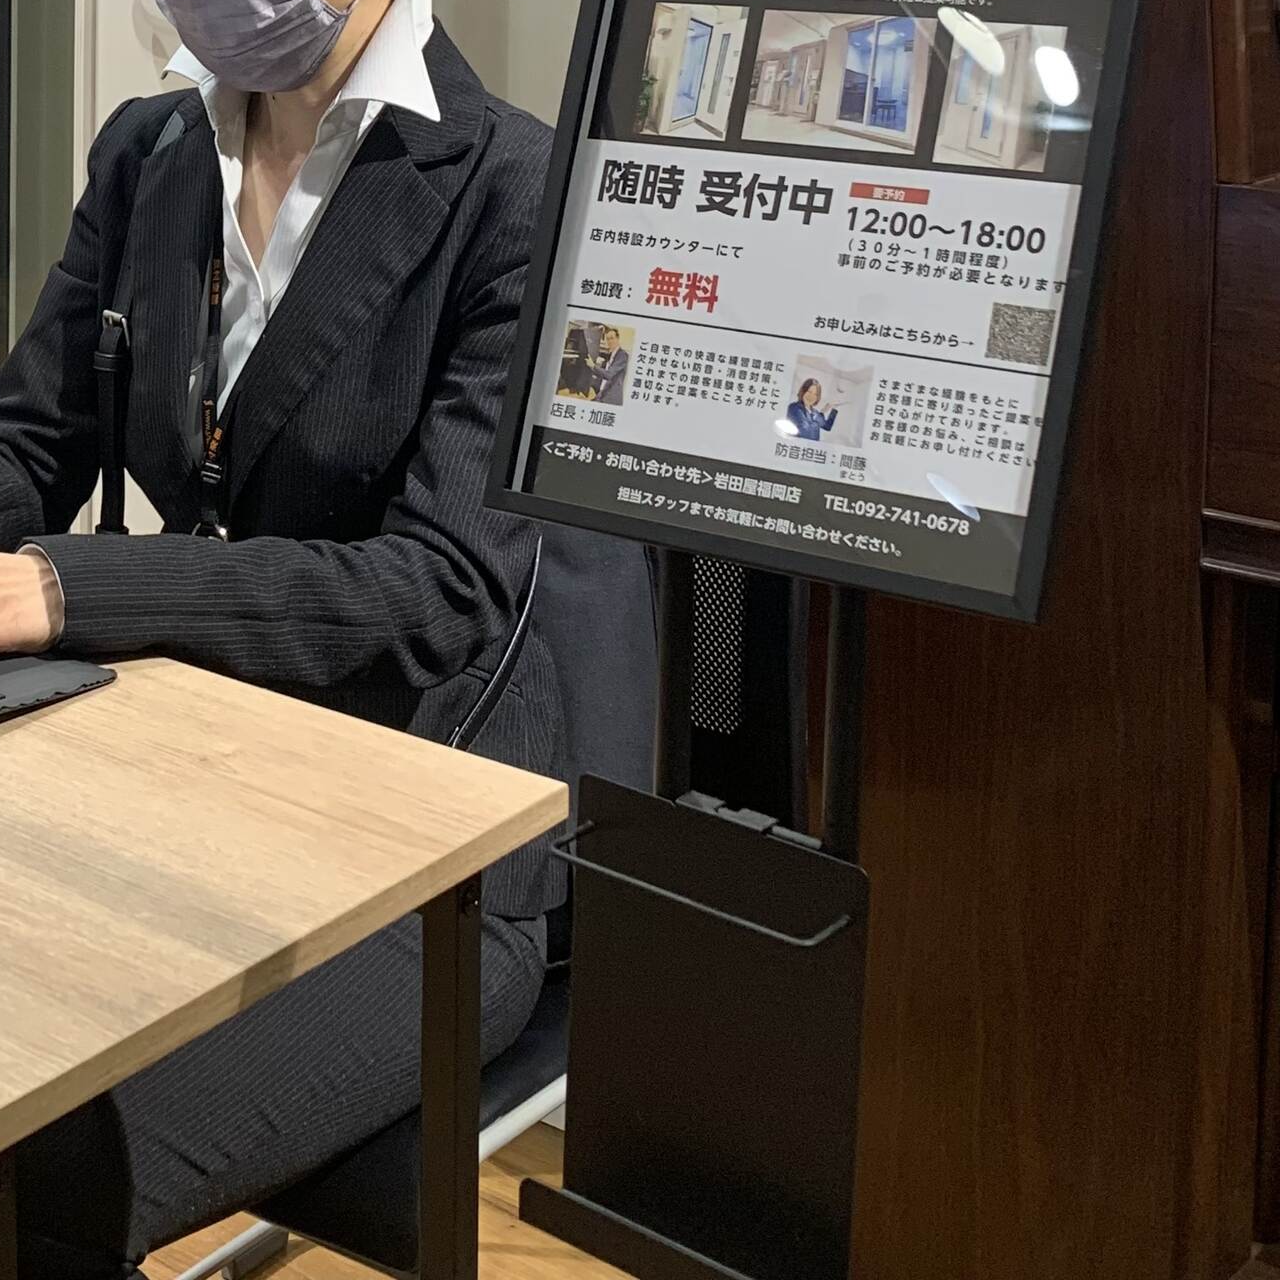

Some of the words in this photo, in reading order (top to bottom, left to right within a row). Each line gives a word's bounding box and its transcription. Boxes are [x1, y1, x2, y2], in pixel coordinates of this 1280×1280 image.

[597, 159, 685, 209] 随時
[696, 170, 834, 226] 受付中
[589, 227, 744, 259] 店内特設カウンターにて
[837, 253, 1068, 294] 事前のご予約が必要となります
[645, 267, 719, 313] 無料
[639, 341, 785, 373] ご自宅での快適な練習環境に
[632, 378, 779, 411] 適切なご提案をこころがけて
[635, 366, 781, 398] これまでの接客経験をもとに
[879, 378, 1020, 410] さまざまな経験をもとに
[630, 389, 680, 408] おります。
[550, 402, 617, 428] 店長：加藤
[839, 470, 866, 483] まとう
[616, 486, 902, 558] 担当スタッフまでお気軽にお問い合わせください。
[824, 493, 971, 537] TEL:092-741-0678
